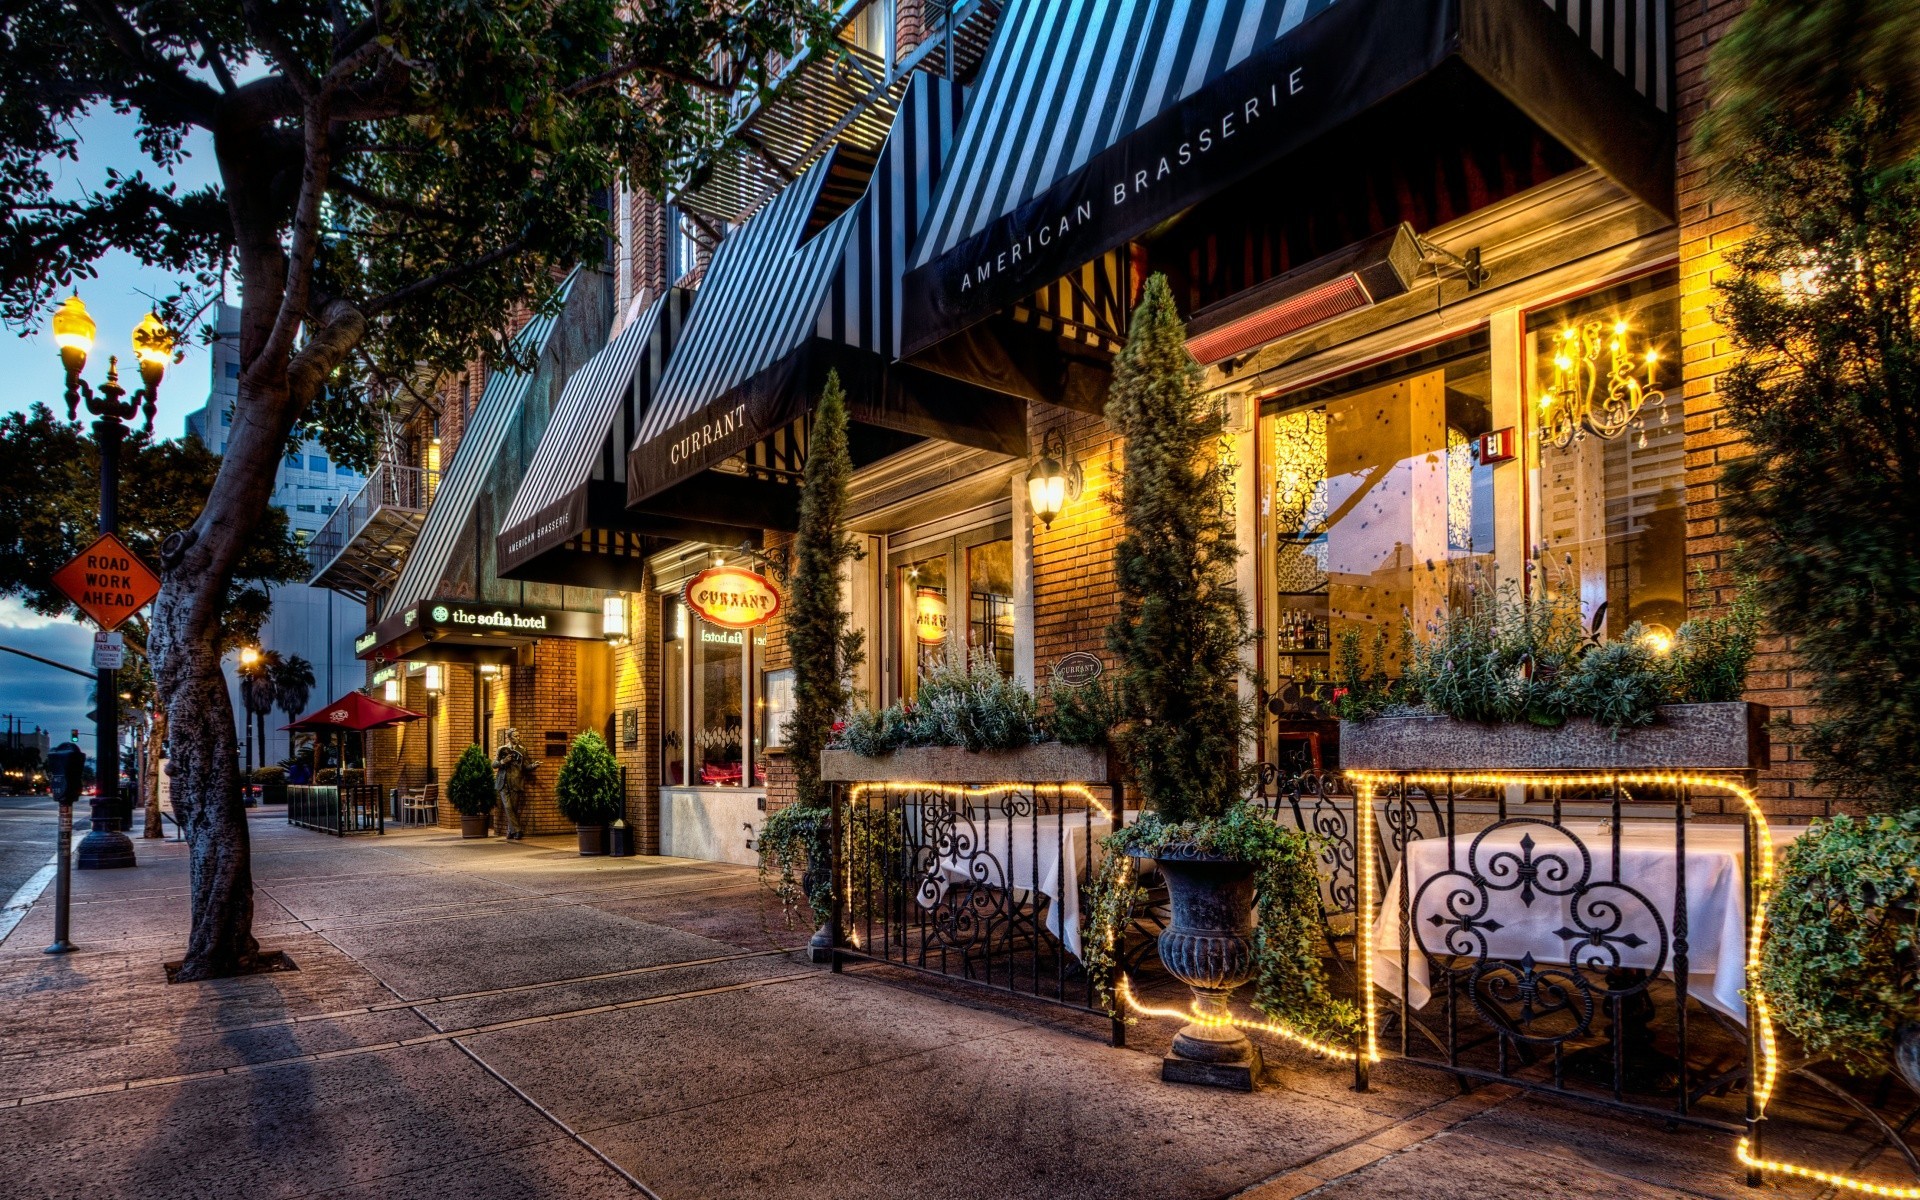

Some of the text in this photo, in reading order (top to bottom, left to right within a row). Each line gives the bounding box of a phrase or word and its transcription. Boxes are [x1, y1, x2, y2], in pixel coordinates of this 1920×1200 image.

[961, 67, 1304, 292] AMERICAN BRASSERIE
[671, 403, 745, 464] CURRANT
[509, 513, 569, 554] AMERICAN BRASSERIE
[87, 555, 130, 571] ROAD
[85, 573, 131, 590] WORK
[81, 591, 135, 607] AHEAD
[698, 590, 769, 609] CURRANT
[452, 609, 547, 629] the sofia hotel
[96, 632, 107, 642] NO
[1061, 664, 1095, 674] CURRANT
